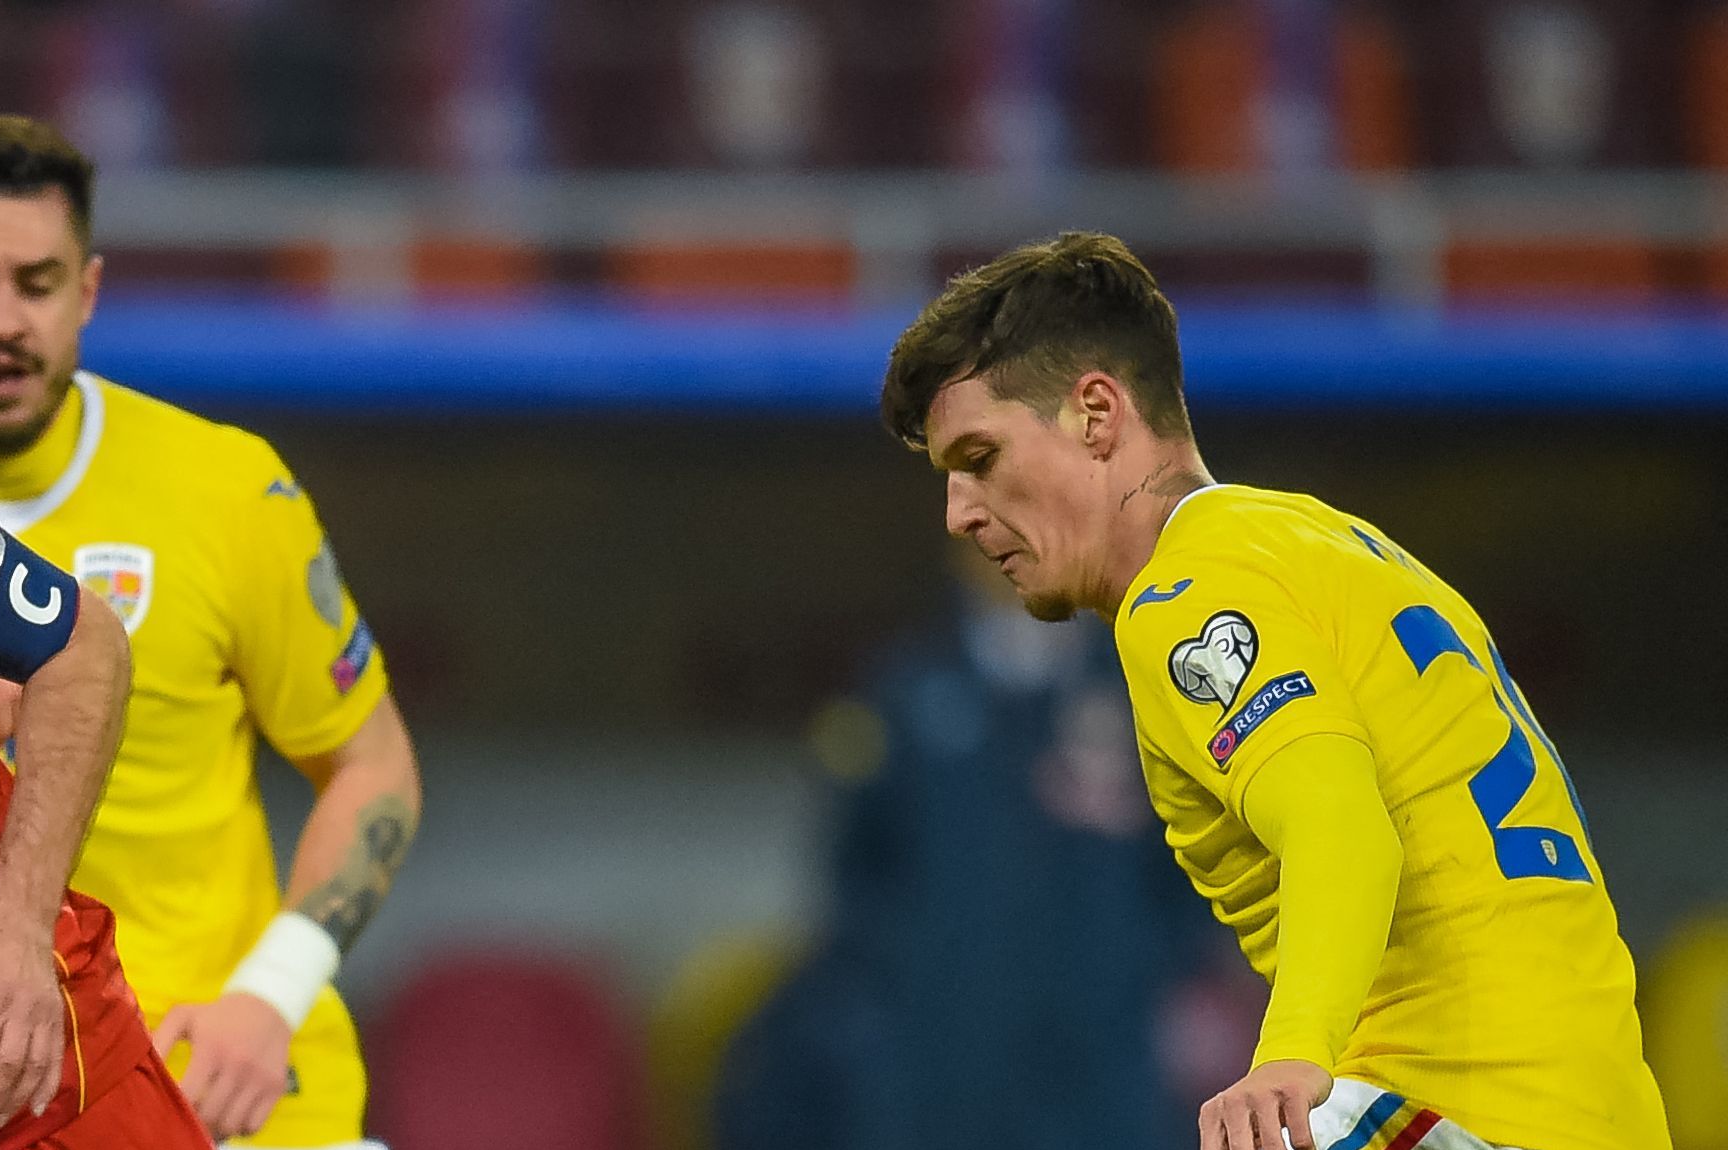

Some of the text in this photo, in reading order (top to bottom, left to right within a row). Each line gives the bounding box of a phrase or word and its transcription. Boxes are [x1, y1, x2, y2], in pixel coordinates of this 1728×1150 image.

[9, 562, 63, 626] C
[1233, 676, 1309, 735] RESPECT
[1390, 603, 1595, 886] 2
